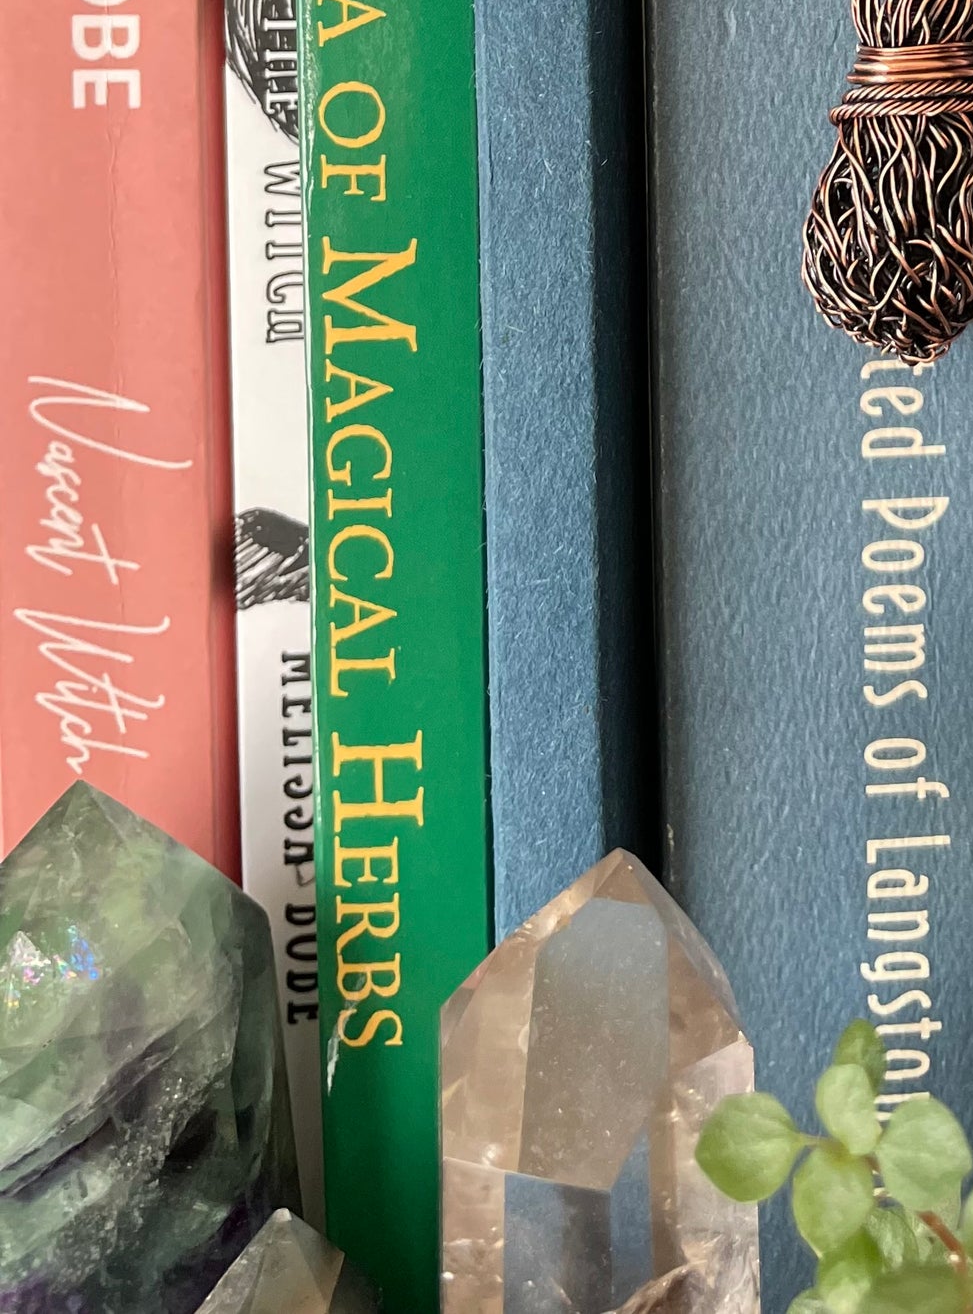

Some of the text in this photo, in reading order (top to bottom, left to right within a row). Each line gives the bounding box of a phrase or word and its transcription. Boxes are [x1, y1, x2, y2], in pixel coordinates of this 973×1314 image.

[318, 81, 388, 202] OF
[13, 375, 193, 776] Nascent Witch
[322, 236, 419, 697] MAGICAL
[861, 496, 950, 707] Poems
[330, 728, 425, 1049] HERBS
[863, 737, 950, 800] of
